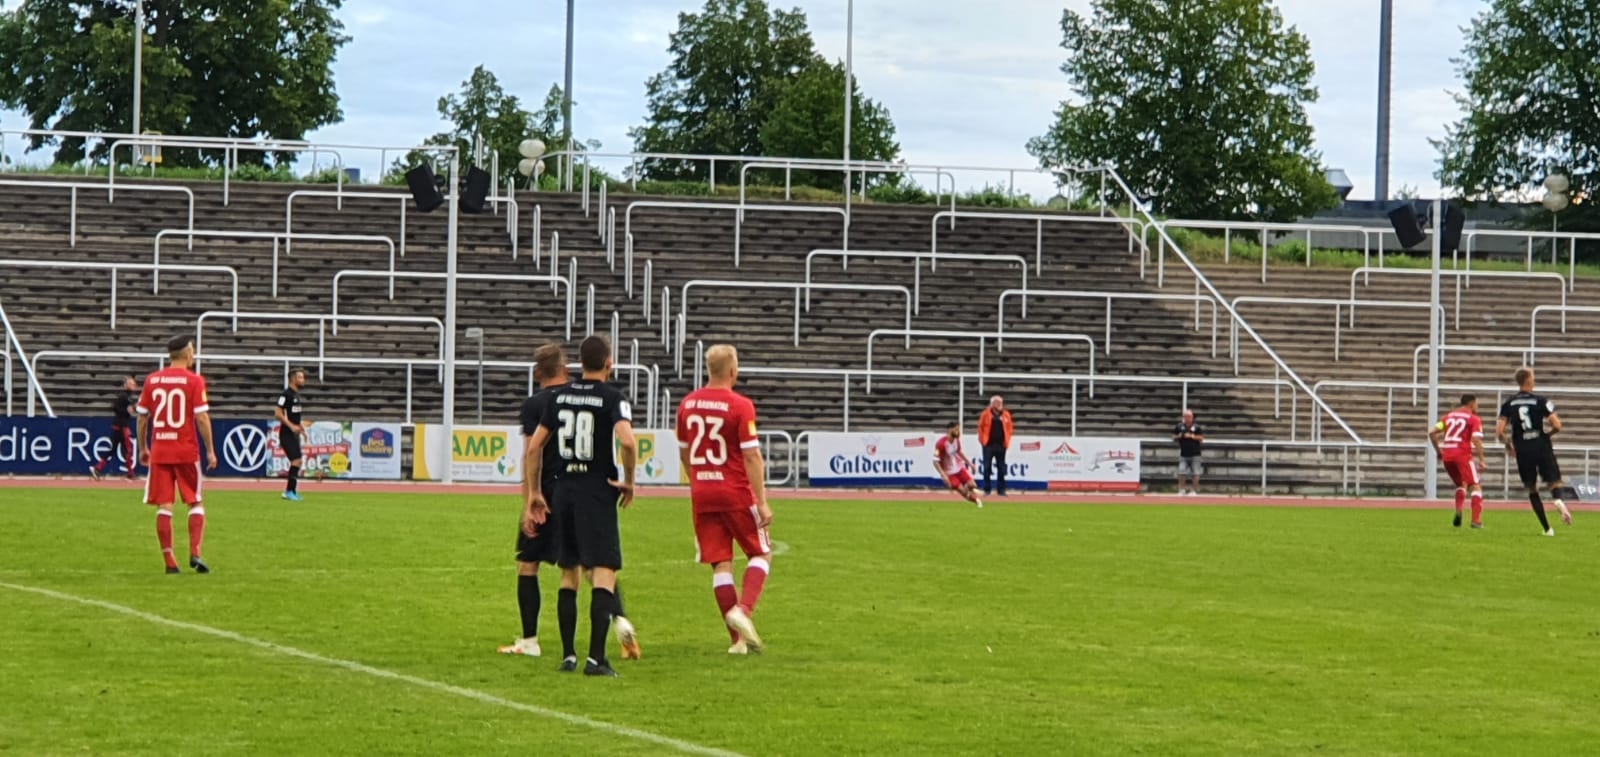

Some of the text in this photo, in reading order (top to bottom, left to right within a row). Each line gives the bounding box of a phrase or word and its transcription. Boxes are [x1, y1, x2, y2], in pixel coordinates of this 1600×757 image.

[152, 388, 186, 429] 20
[1444, 418, 1466, 442] 22
[0, 426, 137, 472] die Reg
[558, 409, 595, 461] 28
[686, 414, 728, 466] 23
[830, 454, 914, 475] Caldener
